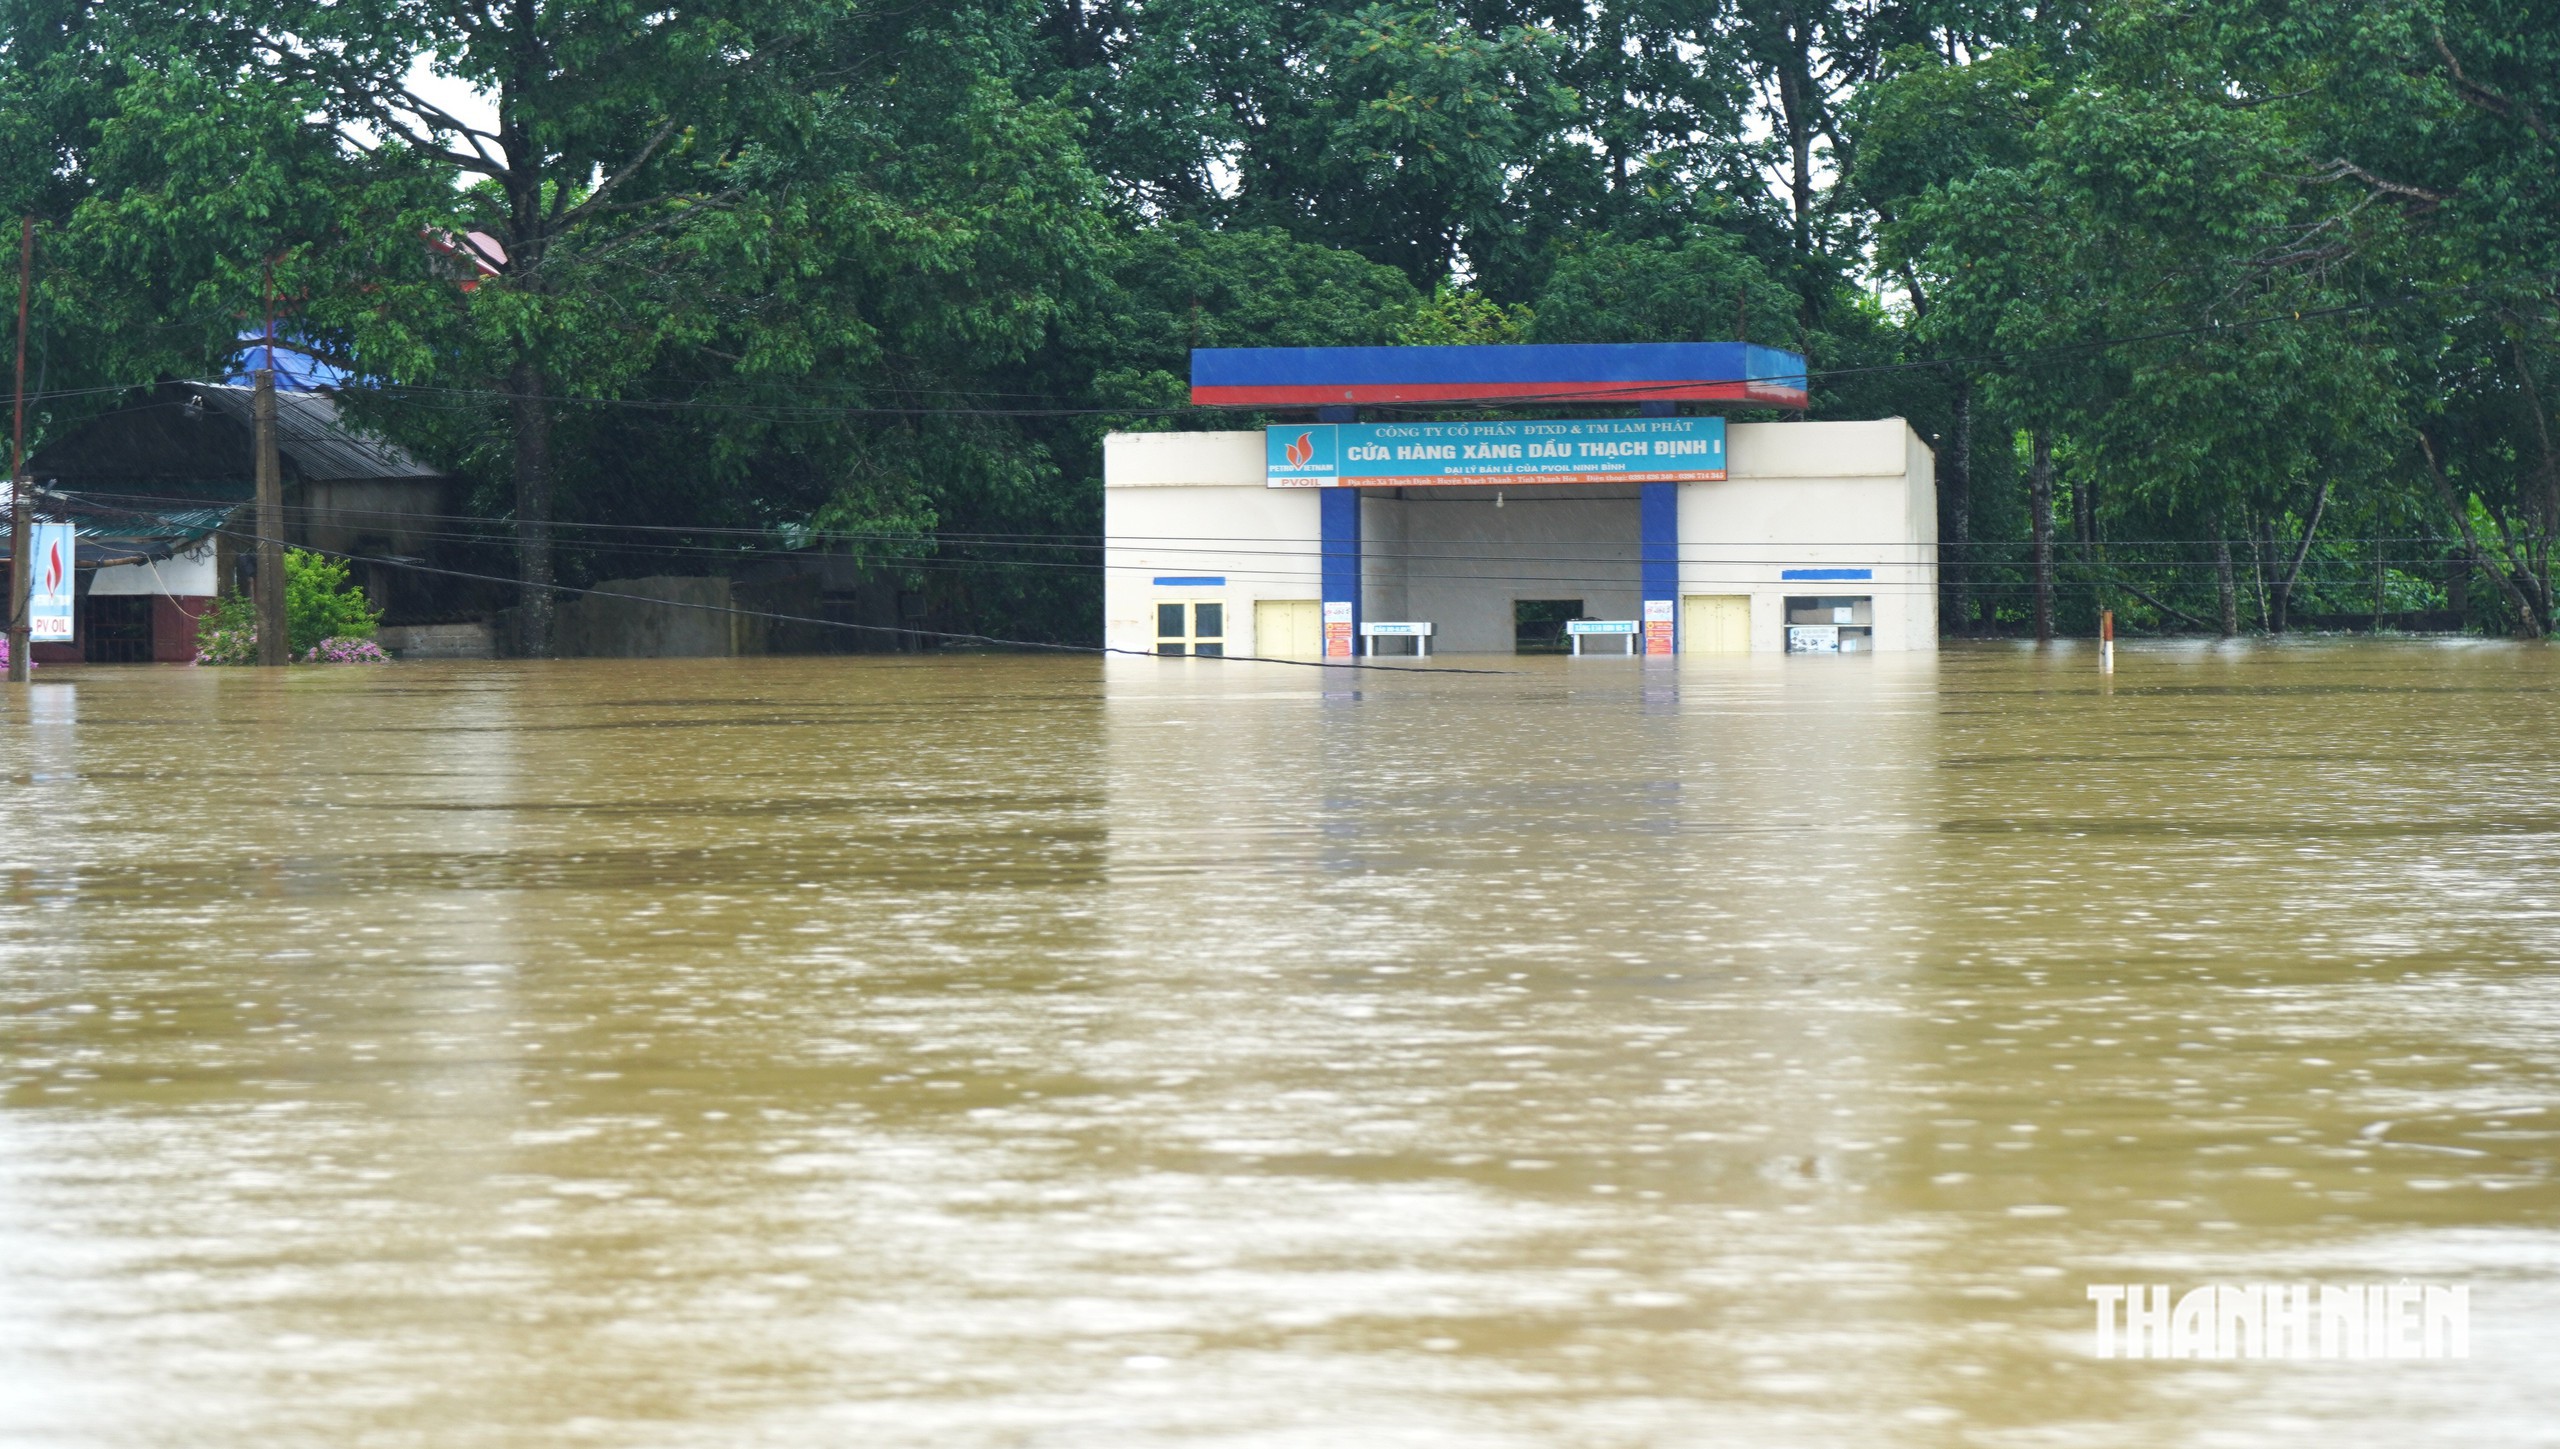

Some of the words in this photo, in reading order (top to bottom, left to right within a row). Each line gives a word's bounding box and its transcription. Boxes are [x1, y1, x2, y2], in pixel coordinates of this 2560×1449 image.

[1376, 425, 1420, 437] CÔNG
[1424, 427, 1443, 436] TY
[1447, 422, 1469, 436] CỔ
[1473, 422, 1517, 436] PHẦN
[1524, 425, 1567, 435] ĐTXD
[1570, 425, 1582, 434] &
[1586, 424, 1609, 434] TM
[1613, 423, 1646, 433] LAM
[1651, 420, 1693, 432] PHÁT
[1348, 442, 1391, 461] CỬA
[1397, 443, 1456, 460] HÀNG
[1462, 442, 1522, 459] XĂNG
[1528, 438, 1572, 458] DẦU
[1578, 442, 1648, 459] THẠCH
[1654, 440, 1707, 458] ĐỊNH
[1444, 466, 1463, 475] ĐẠI
[1479, 464, 1500, 473] BÁN
[1541, 464, 1570, 472] PVOIL
[1601, 462, 1626, 471] BÌNH
[1281, 479, 1321, 487] PVOIL
[36, 619, 49, 632] PV
[51, 619, 67, 632] OIL
